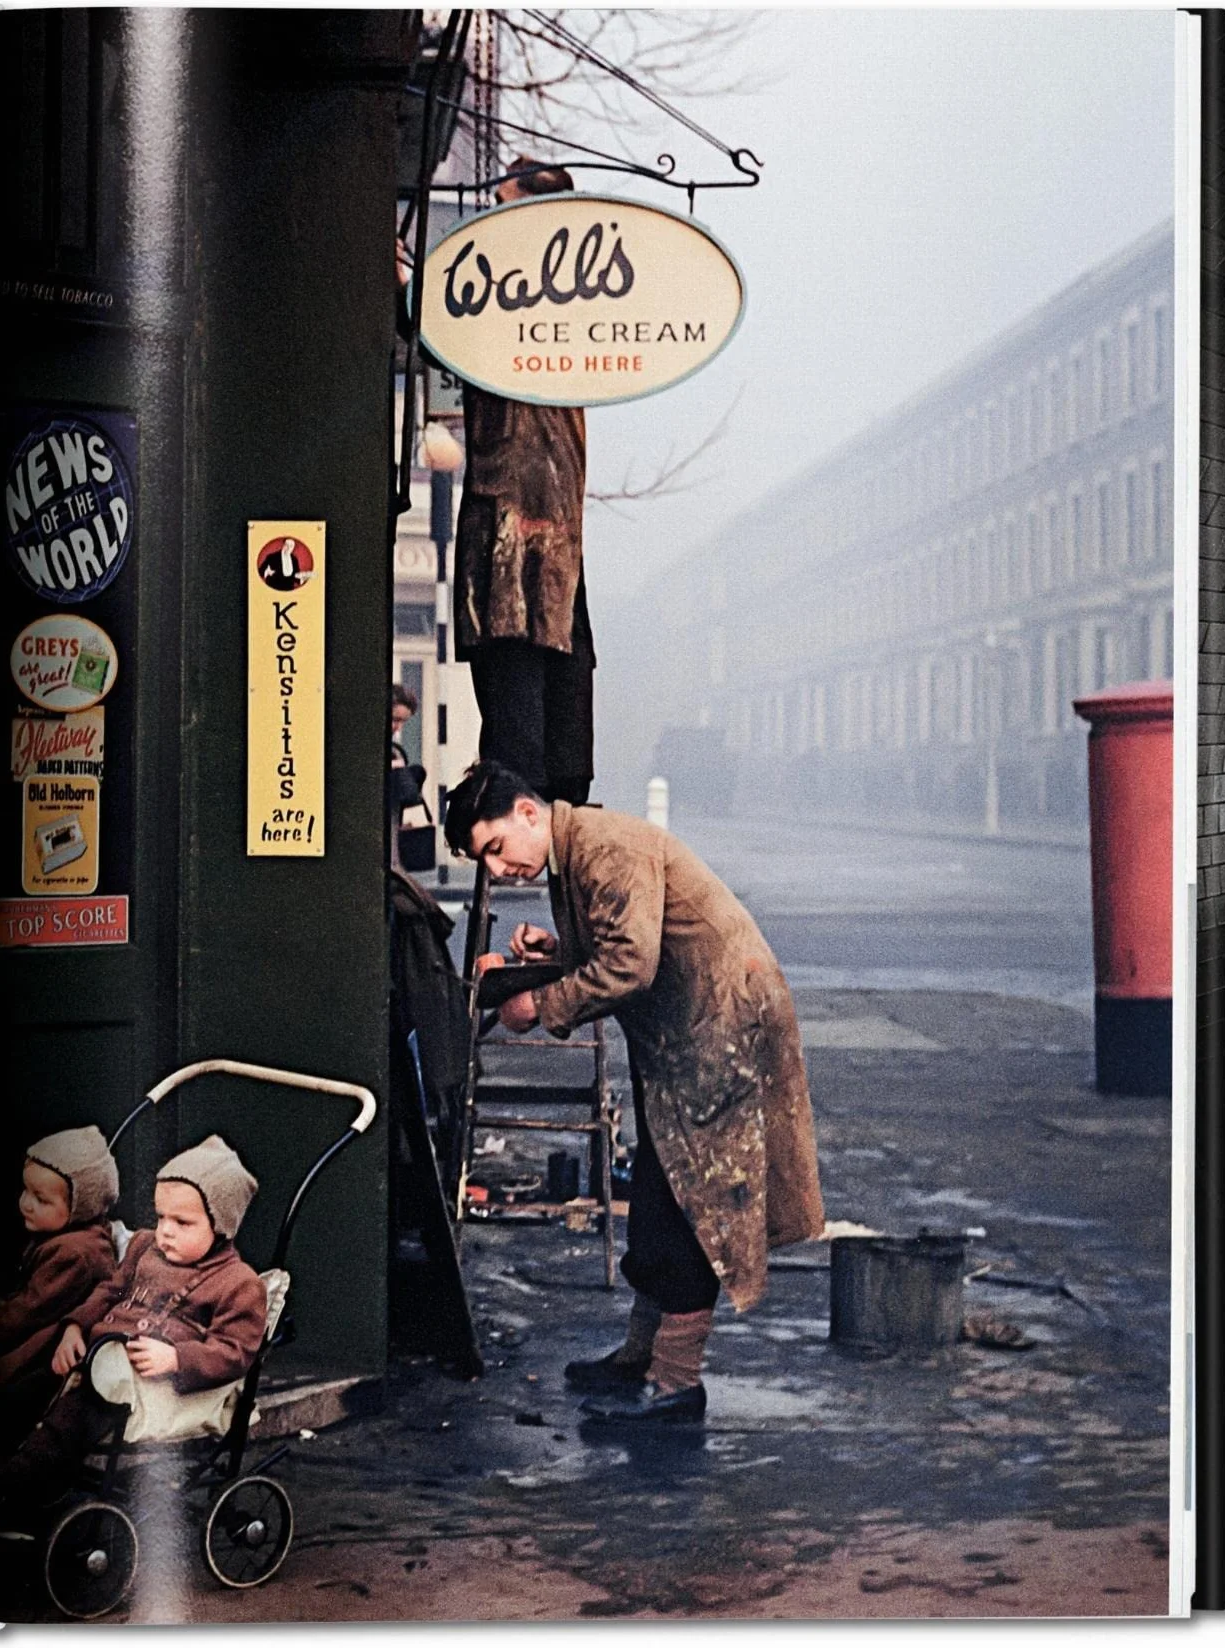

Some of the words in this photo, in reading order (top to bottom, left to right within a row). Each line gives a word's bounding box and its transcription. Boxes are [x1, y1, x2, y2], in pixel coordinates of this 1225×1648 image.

[444, 221, 635, 318] Wall's
[32, 283, 55, 301] SELL
[61, 287, 114, 307] TOBACCO
[518, 323, 570, 344] ICE
[588, 322, 706, 344] CREAM
[513, 355, 573, 372] SOLD
[584, 355, 642, 372] HERE
[5, 432, 113, 534] NEWS
[40, 510, 60, 535] OF
[67, 492, 94, 524] THE
[17, 497, 128, 591] WORLD
[21, 635, 79, 657] GREYS
[19, 661, 39, 676] are
[29, 660, 72, 694] great!
[272, 601, 299, 800] Kensitas
[28, 783, 46, 802] Old
[51, 783, 95, 802] Holborn
[261, 815, 315, 843] here!
[272, 808, 305, 824] are
[7, 915, 45, 940] TOP
[52, 904, 117, 934] SCORE
